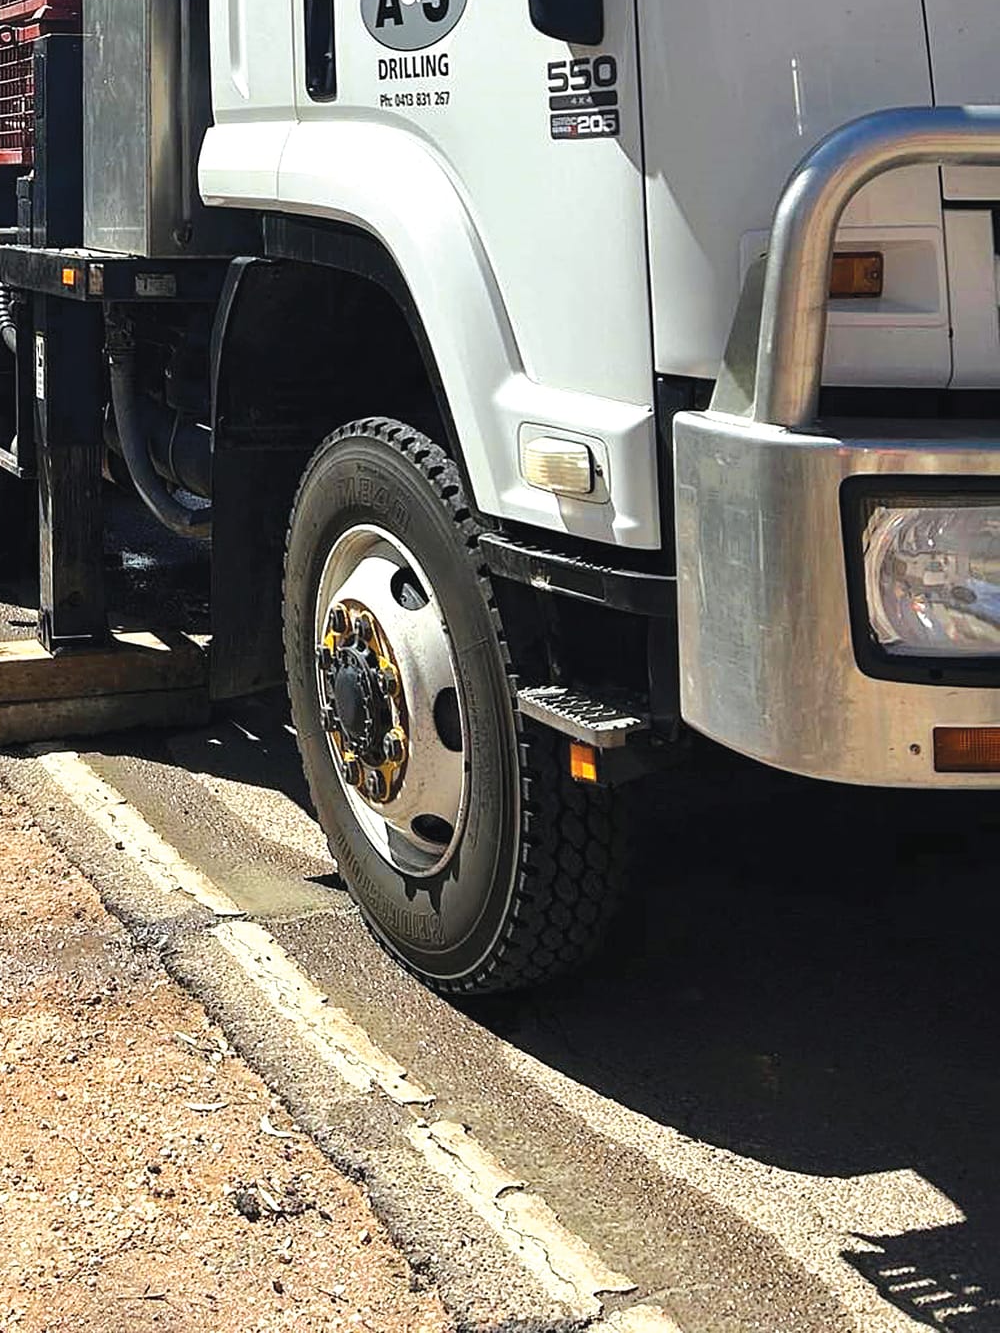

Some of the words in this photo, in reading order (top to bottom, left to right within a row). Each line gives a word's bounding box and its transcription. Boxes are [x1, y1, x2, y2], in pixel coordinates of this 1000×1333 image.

[378, 53, 449, 80] DRILLING
[547, 55, 618, 92] 550
[416, 92, 431, 106] 831
[434, 91, 450, 105] 267
[577, 114, 617, 134] 205
